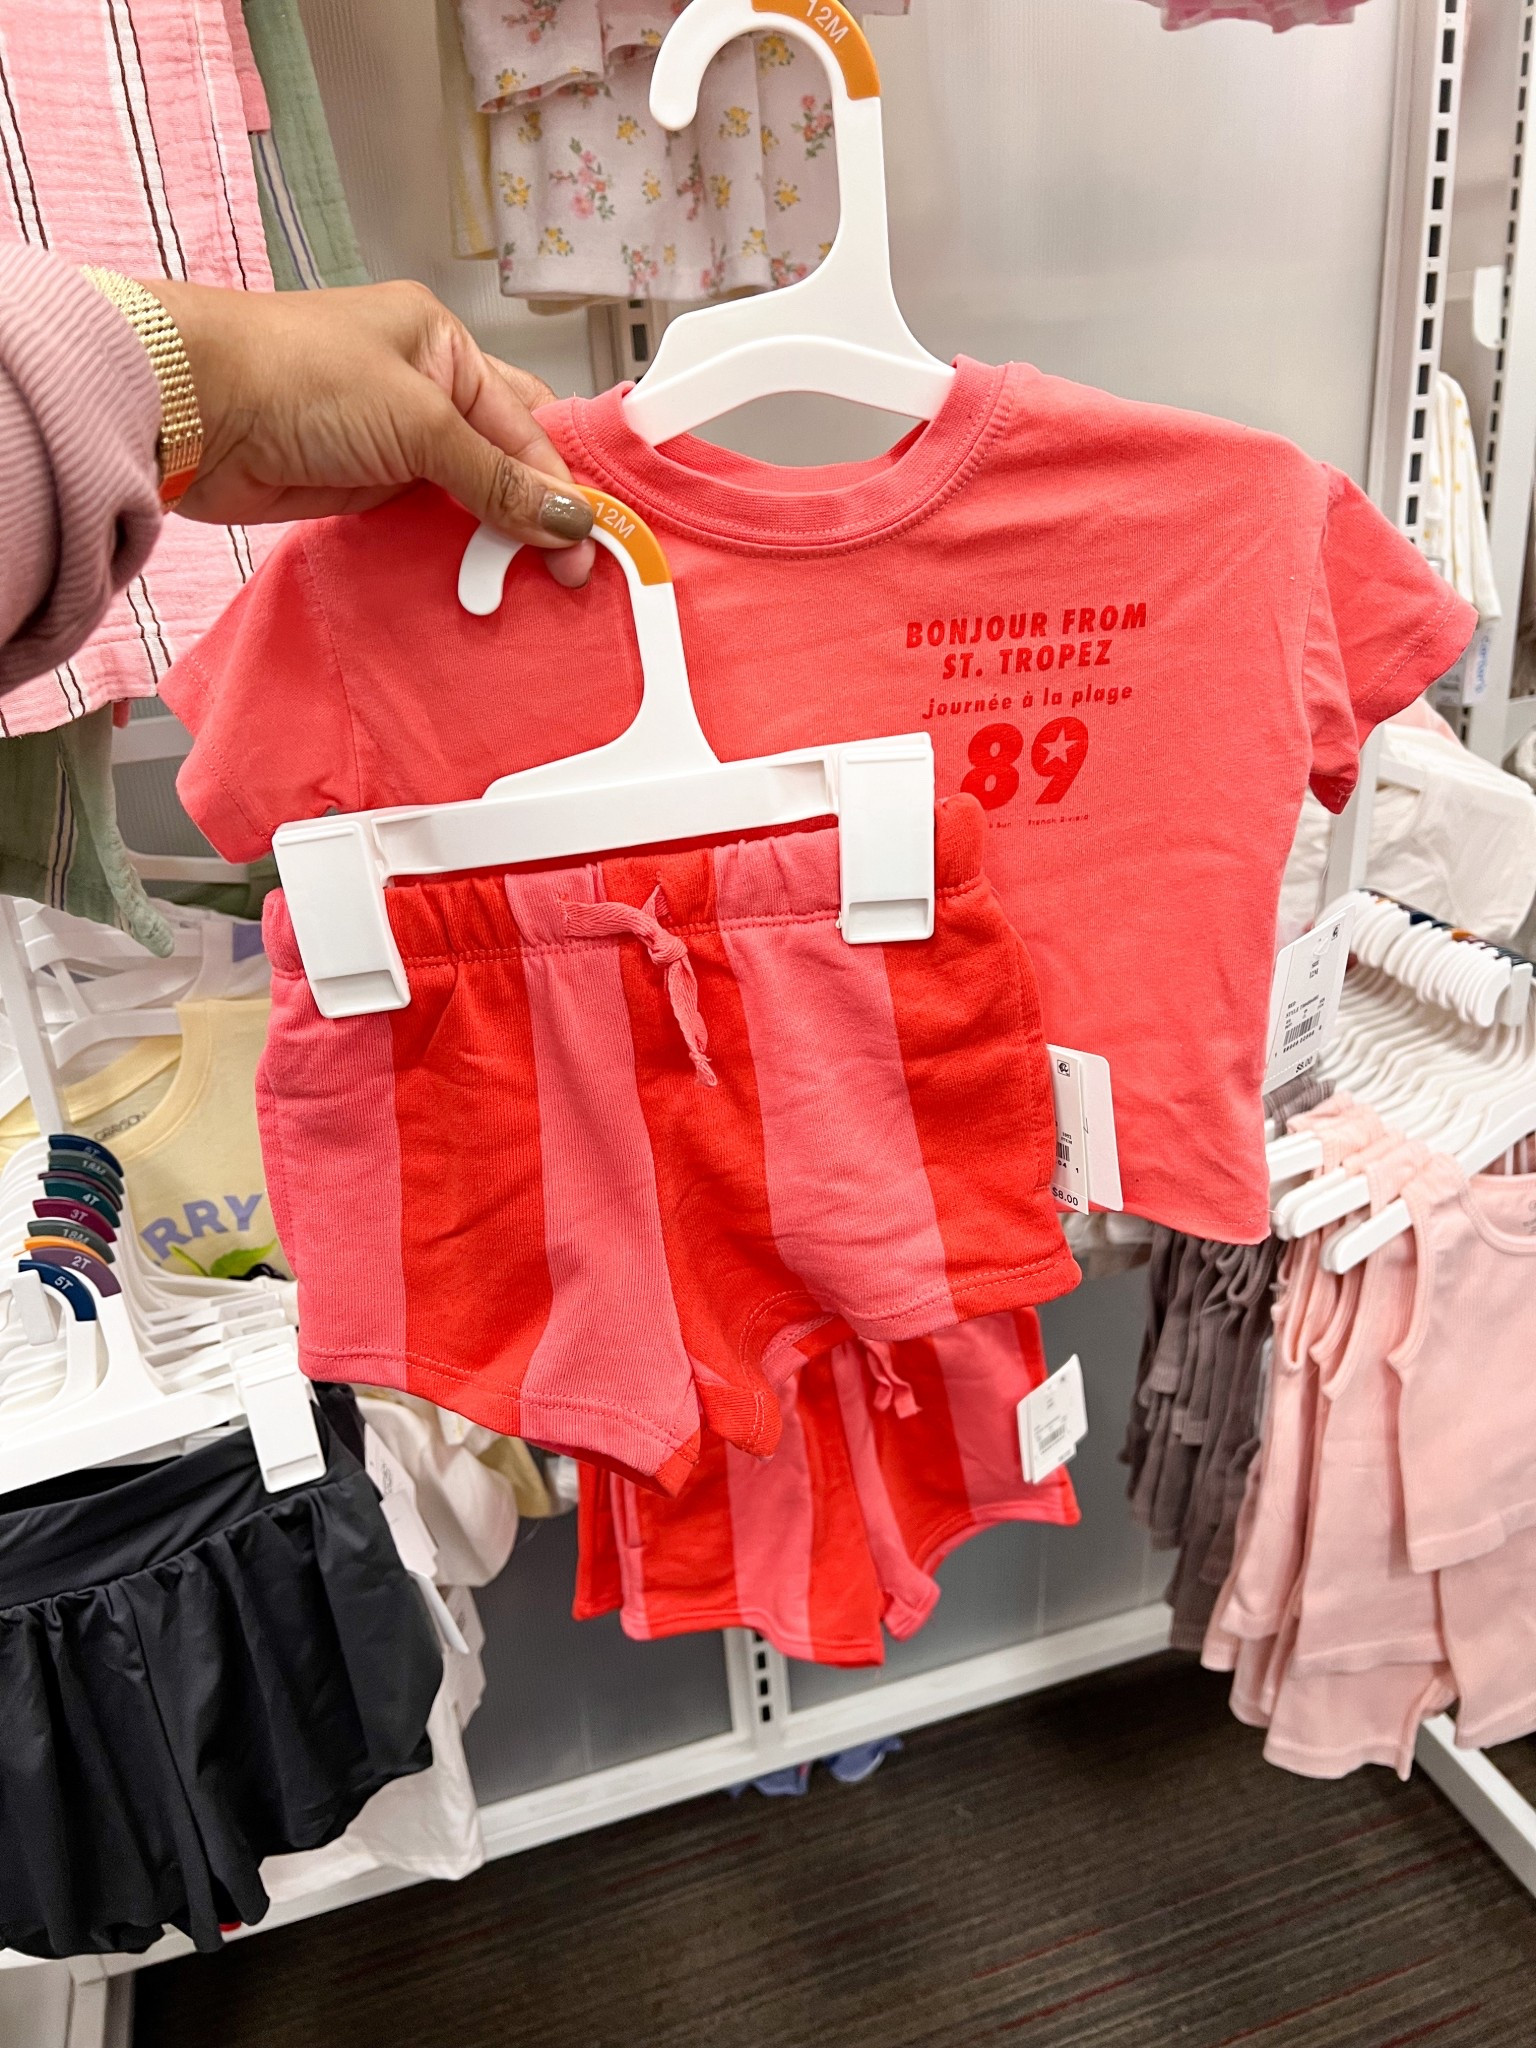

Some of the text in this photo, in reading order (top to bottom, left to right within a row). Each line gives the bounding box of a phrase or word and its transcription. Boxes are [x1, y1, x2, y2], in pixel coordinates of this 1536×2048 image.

[807, 0, 849, 44] 12M
[595, 502, 636, 539] 12M
[906, 602, 1147, 649] BONJOUR FROM
[942, 639, 1113, 680] ST. TROPEZ
[921, 684, 1133, 720] journée à la plage
[959, 715, 1090, 812] 89
[82, 1193, 101, 1206] 4T
[1052, 1186, 1079, 1206] $8.00
[70, 1208, 89, 1221] 3T
[139, 1193, 263, 1261] RRY
[62, 1228, 91, 1243] 18M
[71, 1255, 92, 1270] 2T
[54, 1275, 74, 1290] 5T
